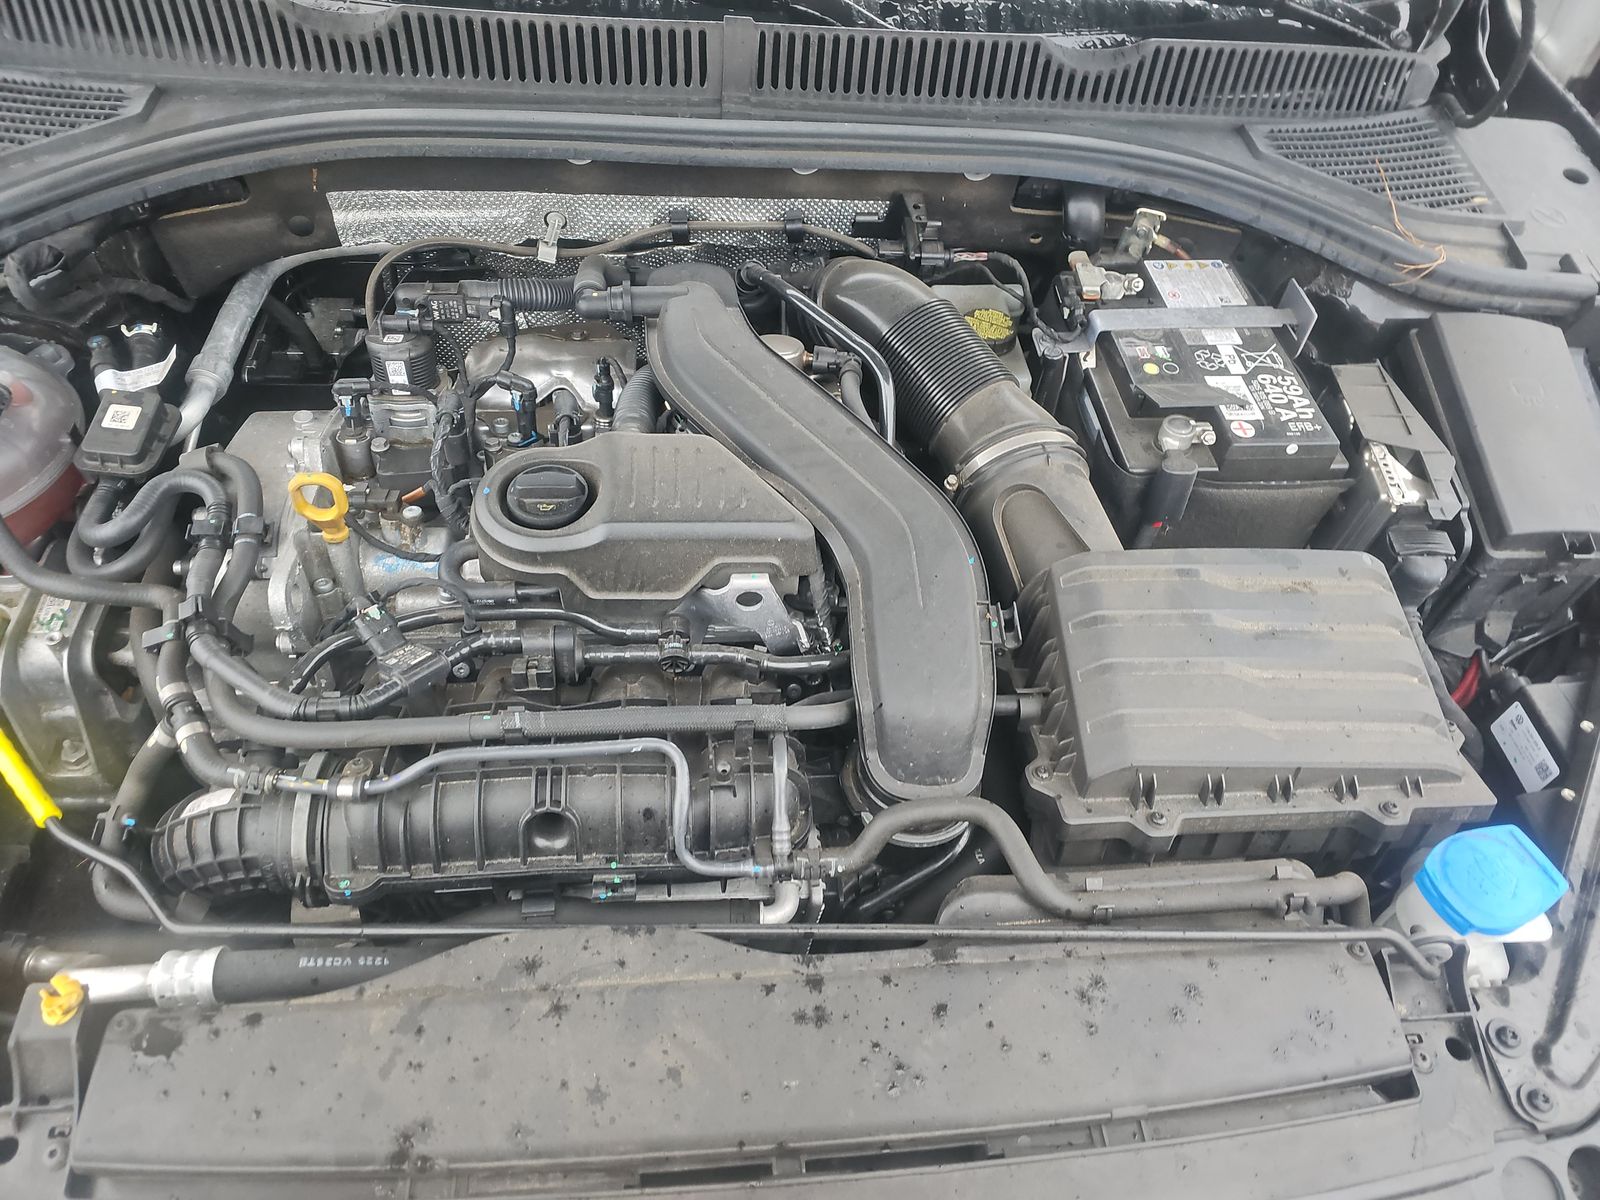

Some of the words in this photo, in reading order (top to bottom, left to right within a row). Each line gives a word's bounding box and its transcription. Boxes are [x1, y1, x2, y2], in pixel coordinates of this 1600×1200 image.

[1257, 373, 1288, 404] 640
[1275, 407, 1298, 422] A
[1277, 375, 1316, 419] 59Ah
